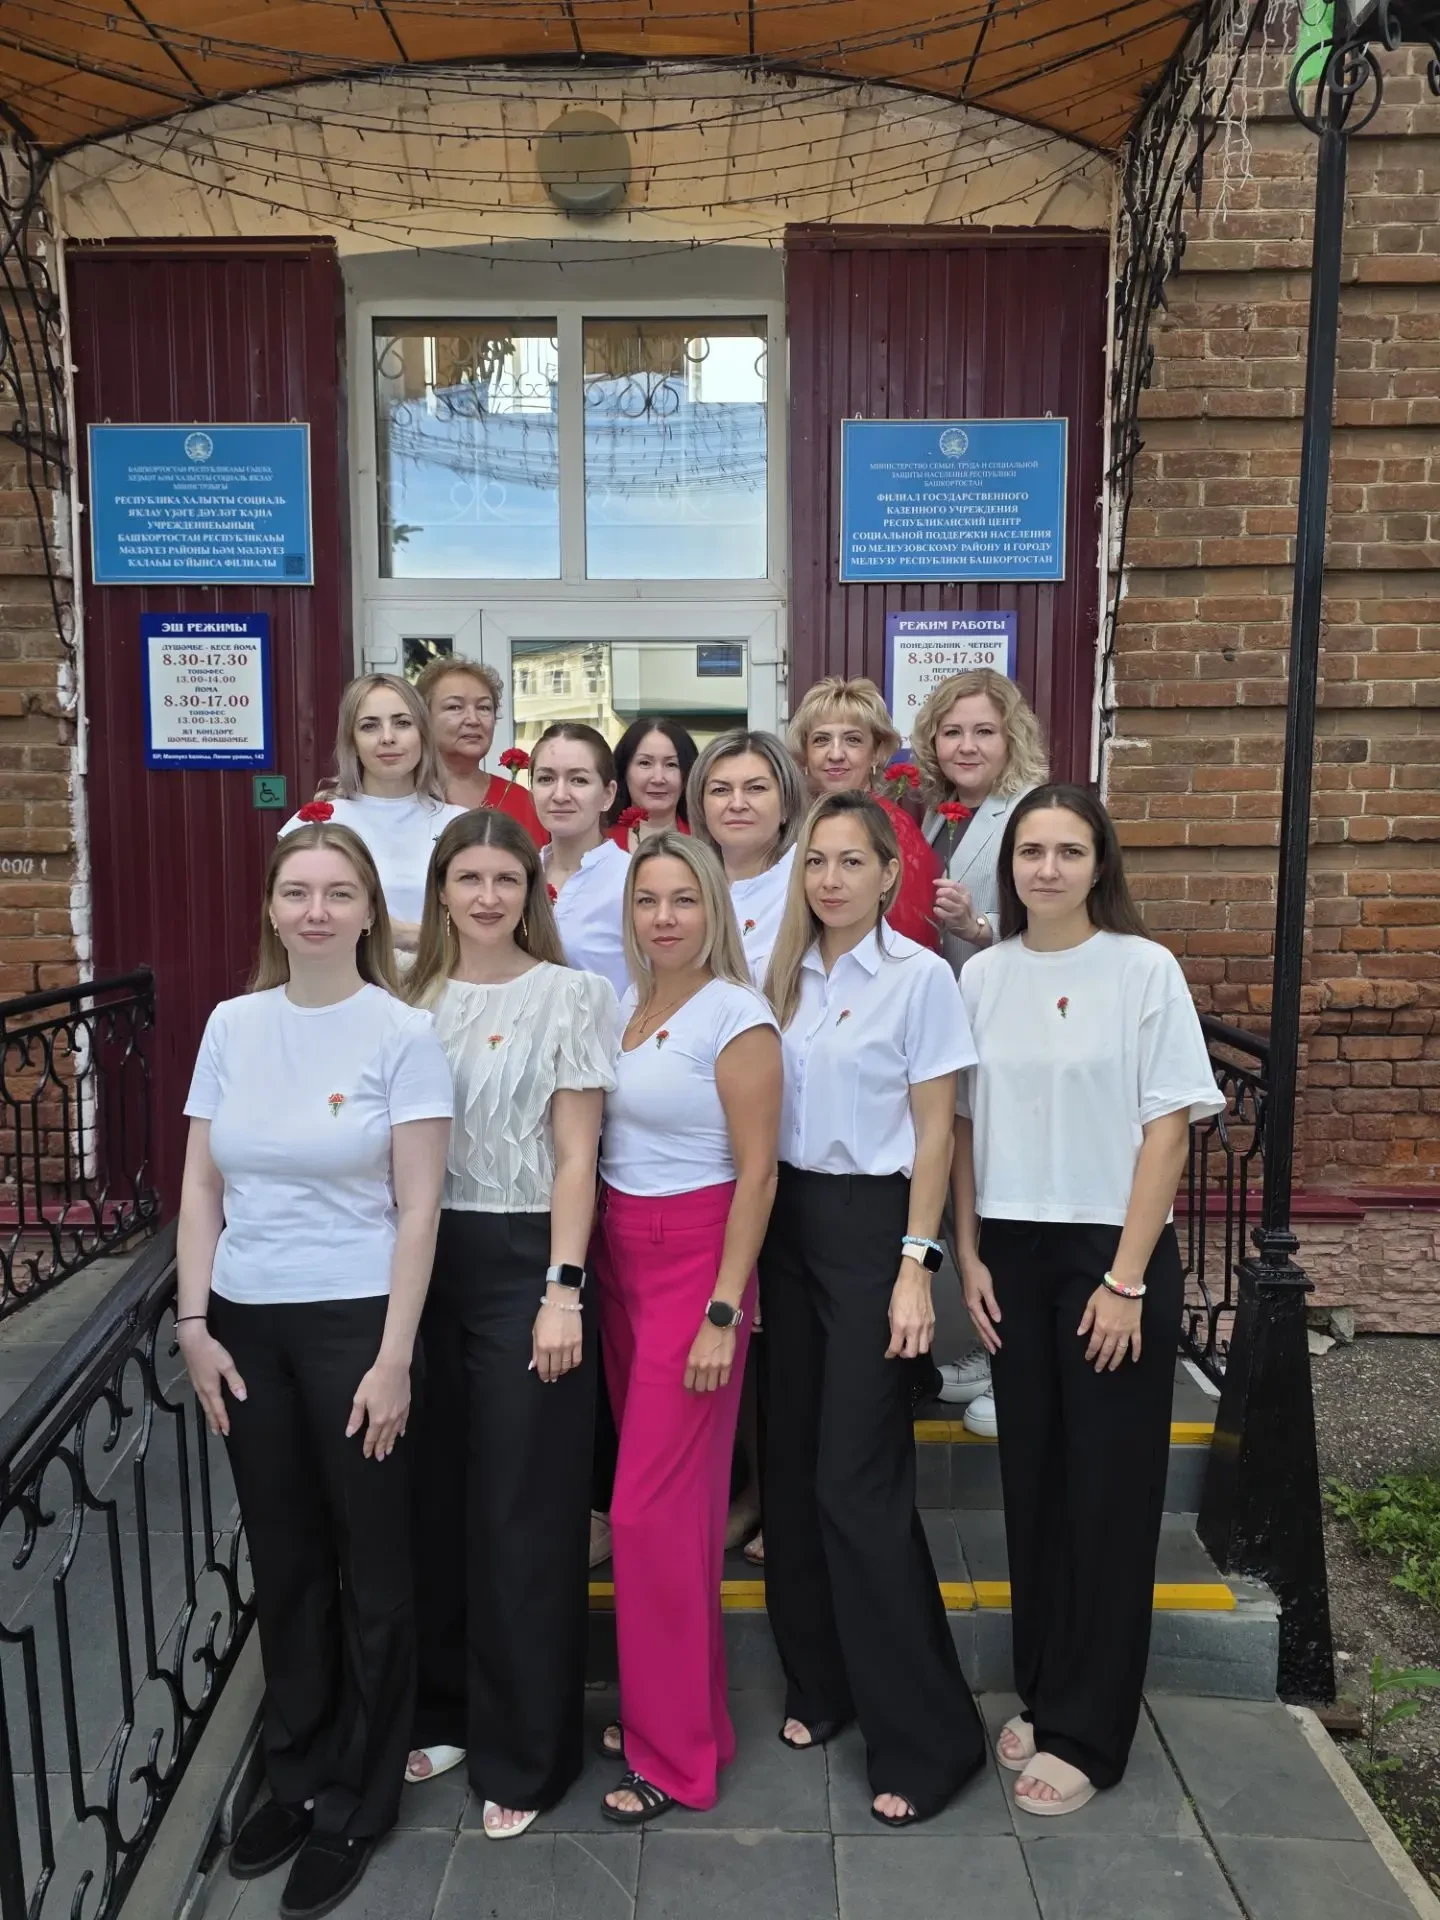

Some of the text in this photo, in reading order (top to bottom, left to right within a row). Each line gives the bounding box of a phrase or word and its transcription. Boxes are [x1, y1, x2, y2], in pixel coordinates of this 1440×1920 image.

[988, 460, 1038, 469] СОЦИАЛЬНОЙ
[970, 470, 1017, 478] РЕСПУБЛИКИ
[876, 492, 1029, 502] ФИЛИАЛ ГОСУДАРСТВЕННОГО
[886, 506, 1018, 514] КАЗЕННОГО УЧРЕЖДЕНИЯ
[883, 518, 1022, 526] РЕСПУБЛИКАНСКИЙ ЦЕНТР
[852, 530, 1052, 540] СОЦИАЛЬНОЙ ПОДДЕРЖКИ НАСЕЛЕНИЯ
[852, 542, 1052, 553] ПО МЕЛЕУЗОВСКОМУ РАЙОНУ И ГОРОДУ
[850, 556, 1053, 566] МЕЛЕУЗУ РЕСПУБЛИКИ БАШКОРТОСТАН
[162, 623, 248, 632] ЭШ РЕЖИМЫ
[899, 620, 1006, 630] РЕЖИМ РАБОТЫ
[162, 654, 248, 666] 8.30-17.30
[908, 652, 994, 664] 8.30-17.30
[176, 676, 236, 684] 13.00-14.00
[164, 695, 249, 707] 8.30-17.00
